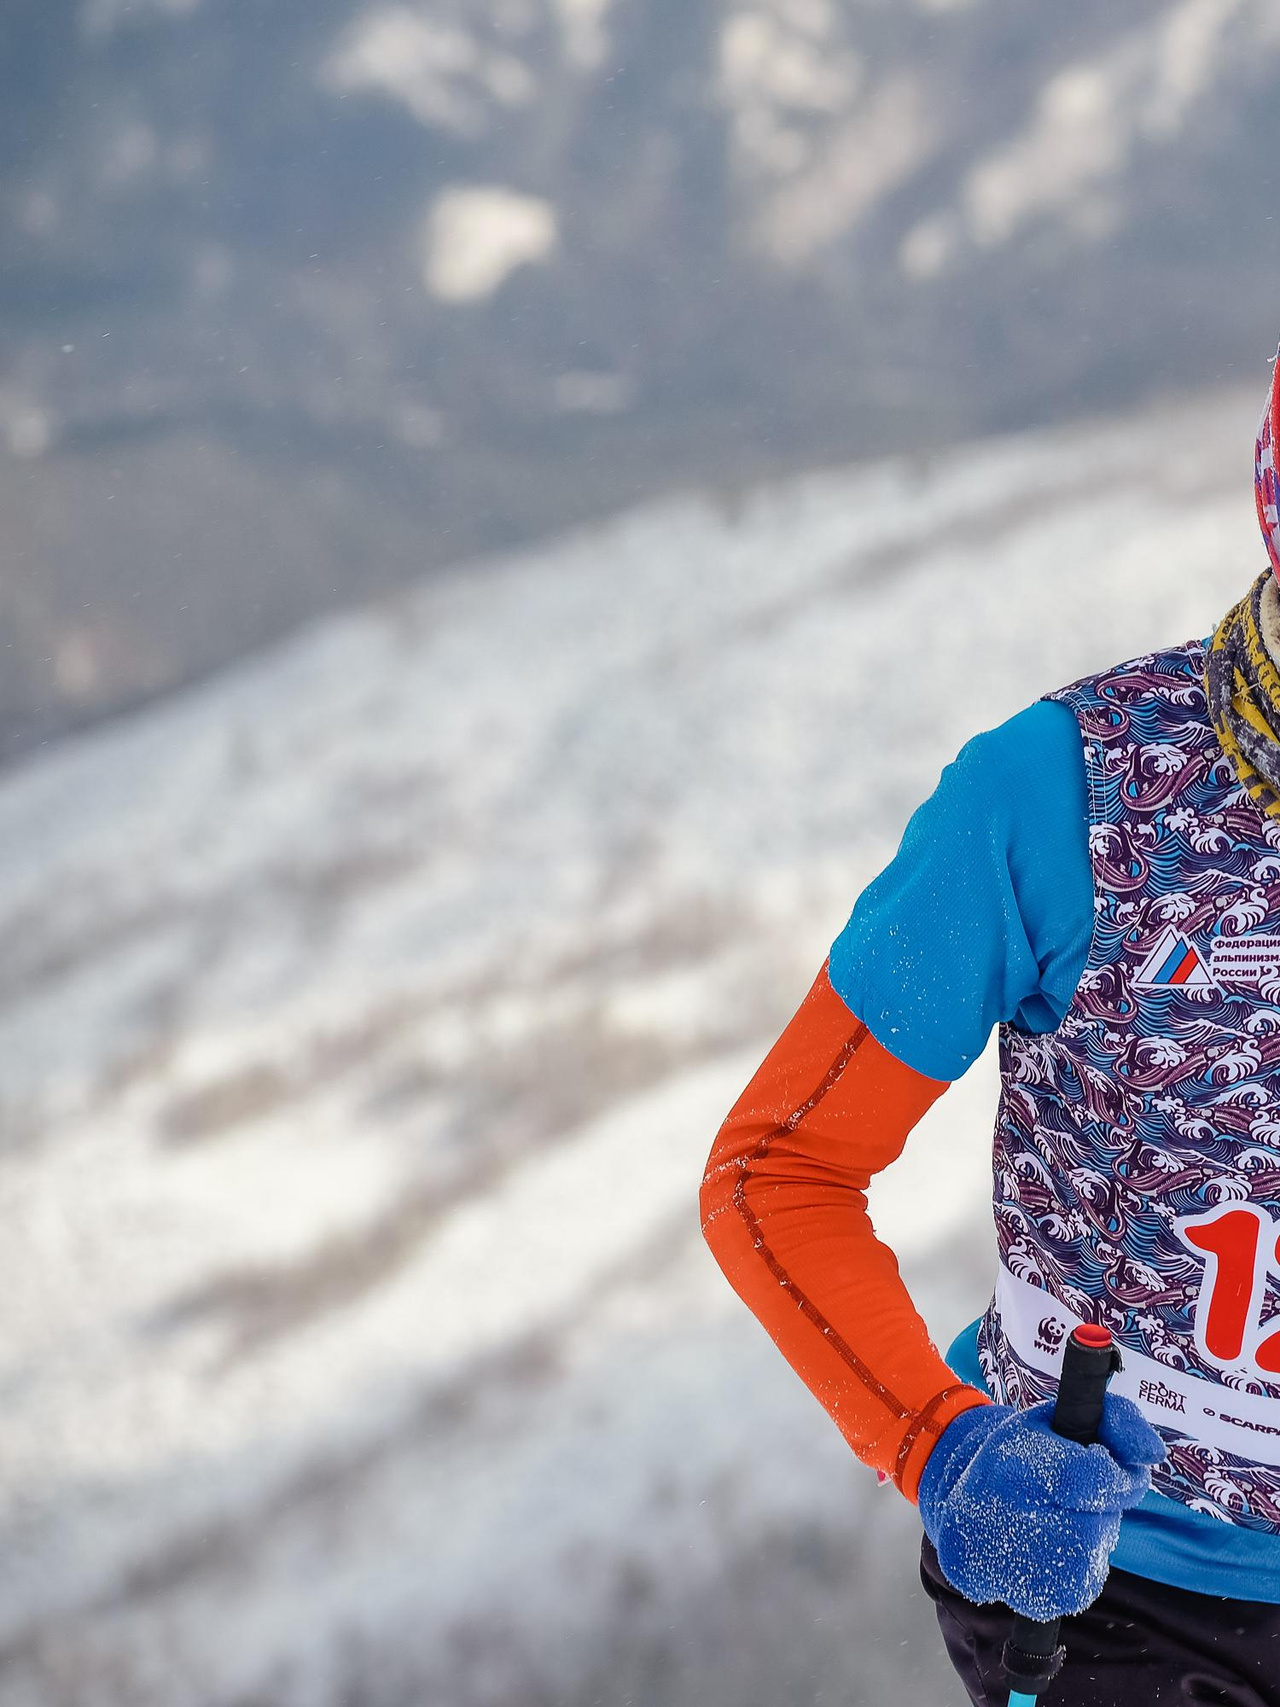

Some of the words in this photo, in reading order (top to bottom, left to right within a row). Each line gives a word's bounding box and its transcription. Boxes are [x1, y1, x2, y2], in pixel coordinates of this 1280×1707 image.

[1212, 967, 1257, 977] России
[1034, 1340, 1059, 1356] WWF
[1138, 1389, 1186, 1414] FERMA
[1139, 1380, 1187, 1405] SPORT
